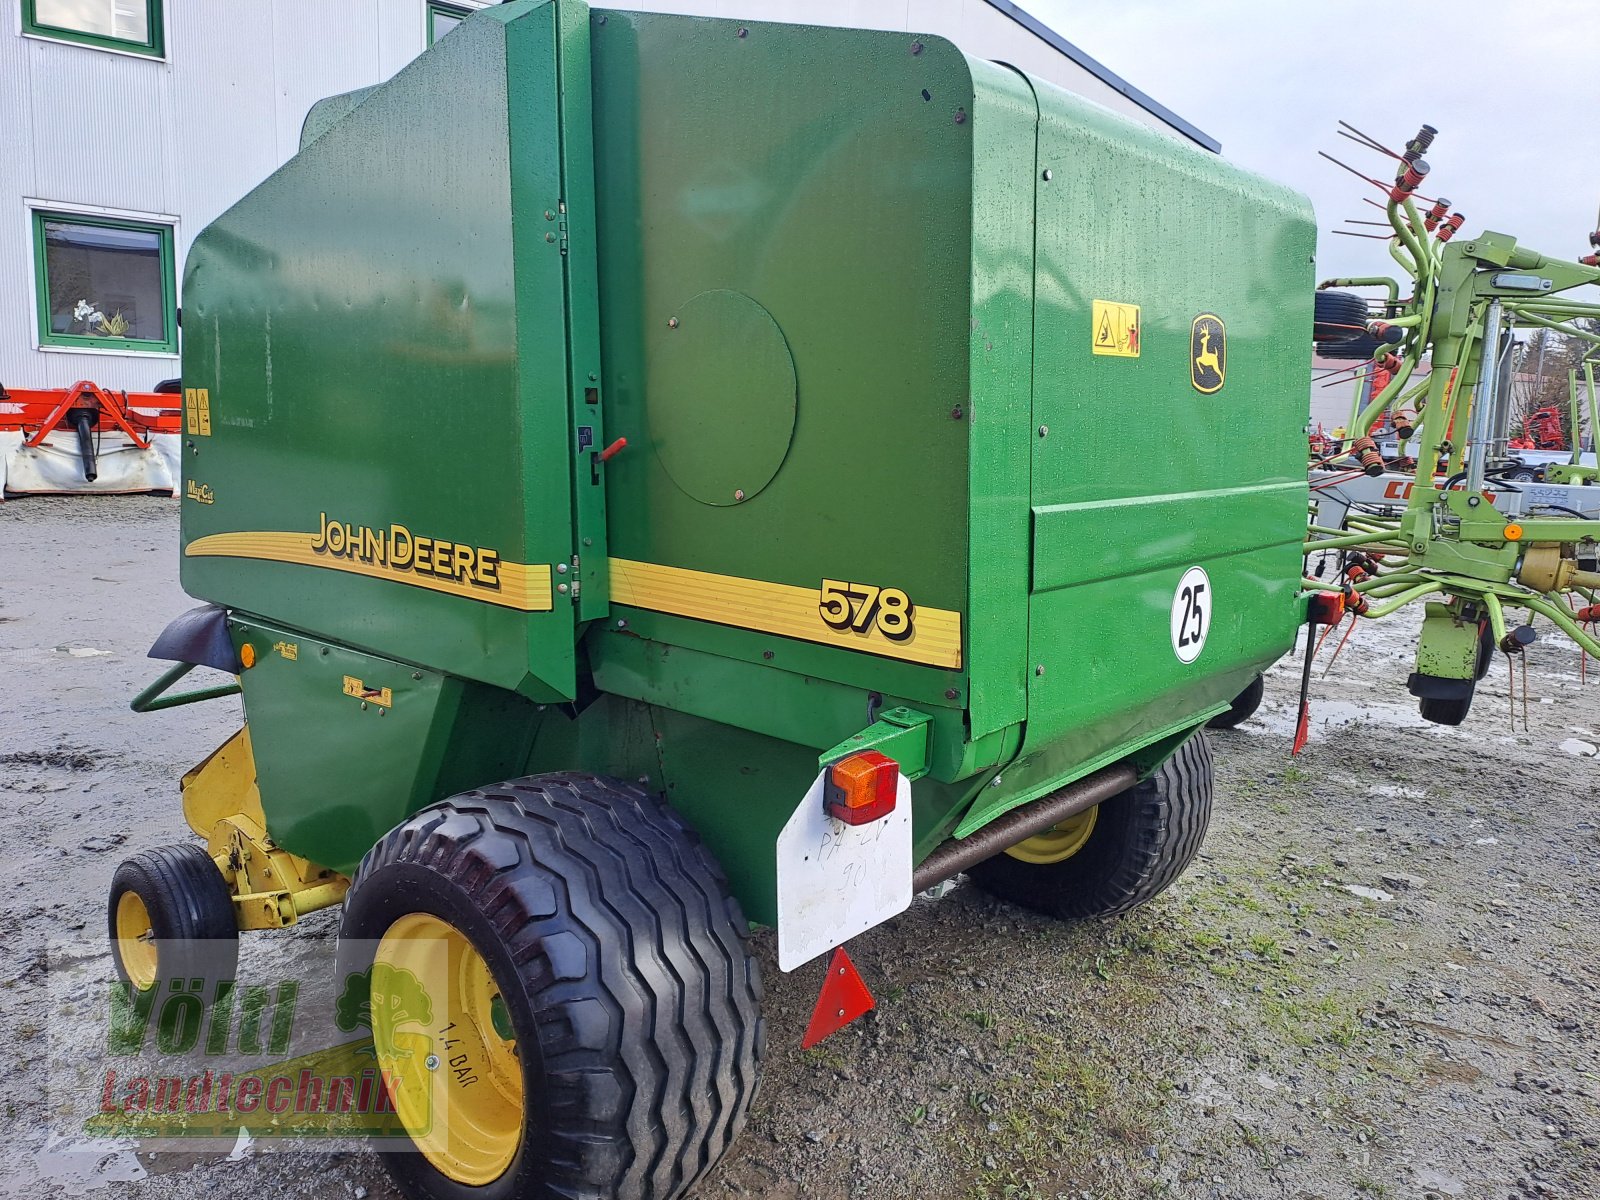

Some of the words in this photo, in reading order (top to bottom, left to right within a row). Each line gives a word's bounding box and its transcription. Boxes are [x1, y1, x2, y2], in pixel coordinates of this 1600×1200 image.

[311, 511, 387, 567] JOHN
[389, 523, 501, 591] DEERE
[819, 577, 914, 642] 578
[1178, 584, 1205, 648] 25
[438, 1022, 461, 1051] 1,4
[449, 1053, 479, 1088] BAR
